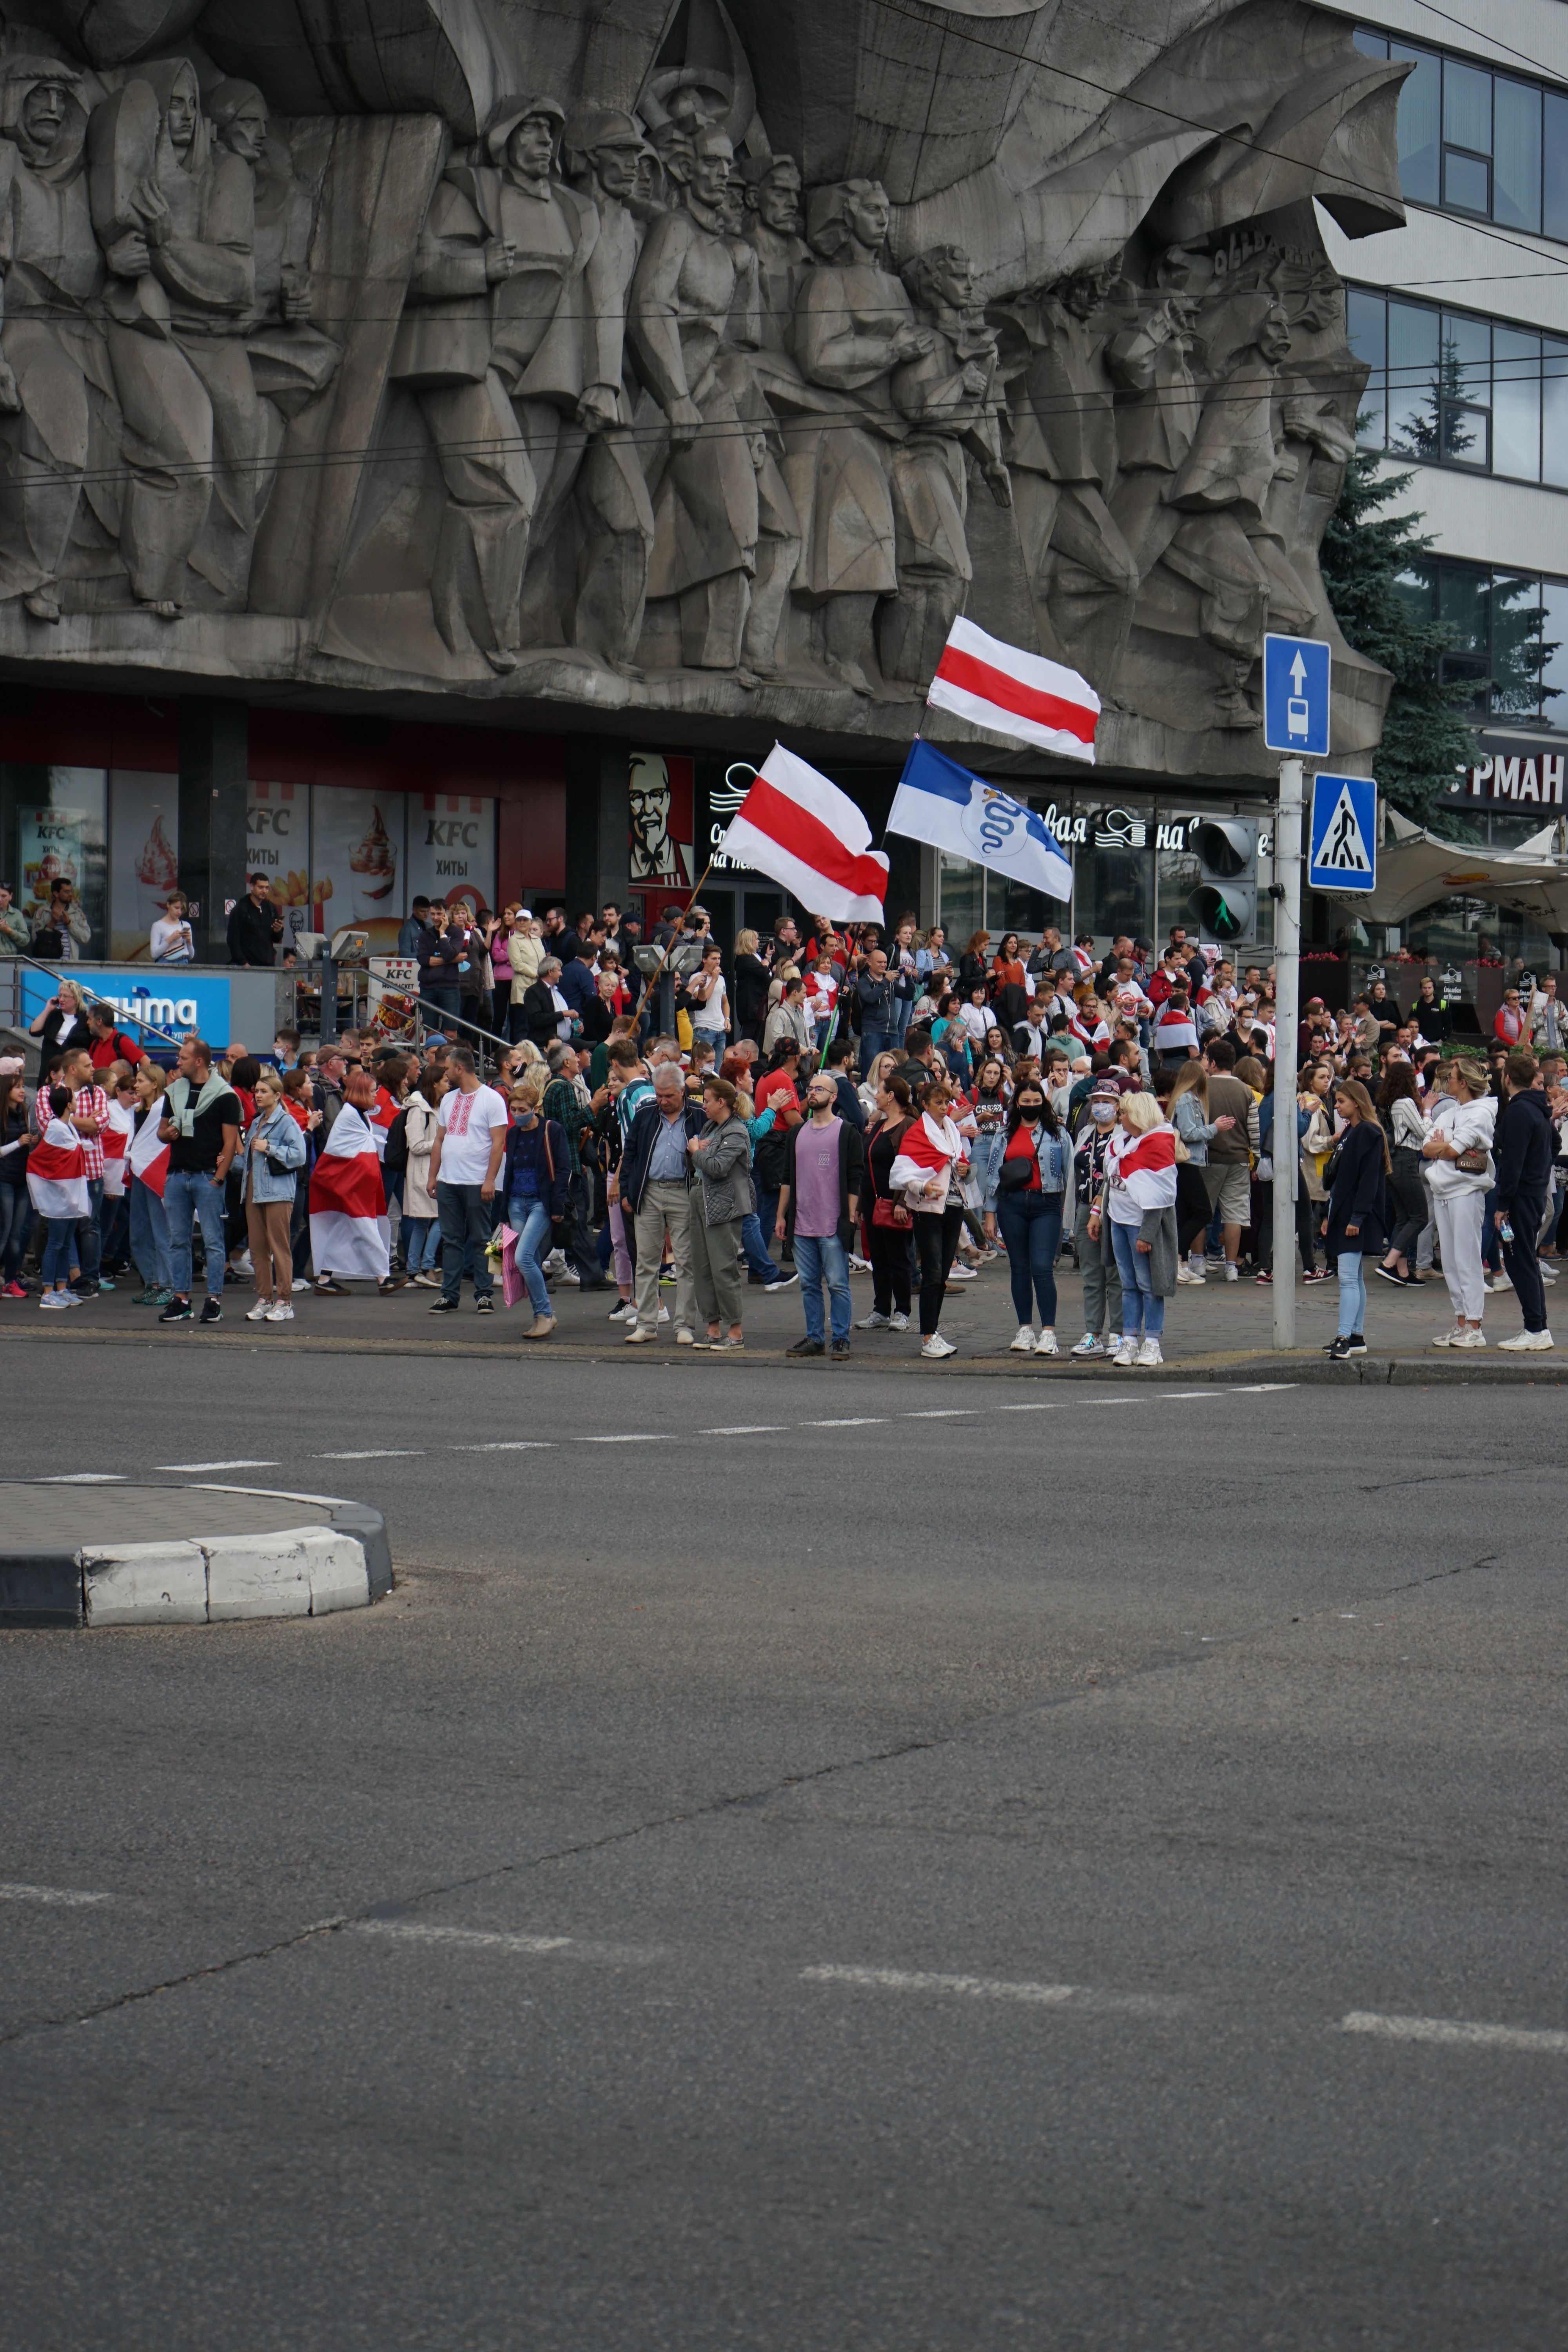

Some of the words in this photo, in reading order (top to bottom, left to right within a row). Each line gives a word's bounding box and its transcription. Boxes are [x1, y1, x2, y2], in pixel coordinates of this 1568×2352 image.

[1450, 753, 1565, 804] РМАН
[37, 826, 65, 840] KFC
[425, 819, 479, 848] KFC
[1156, 824, 1184, 850] на
[43, 845, 60, 853] ХИТЫ
[246, 848, 279, 865] ХИТЫ
[436, 859, 468, 877] ХИТЫ
[385, 969, 412, 980] KFC
